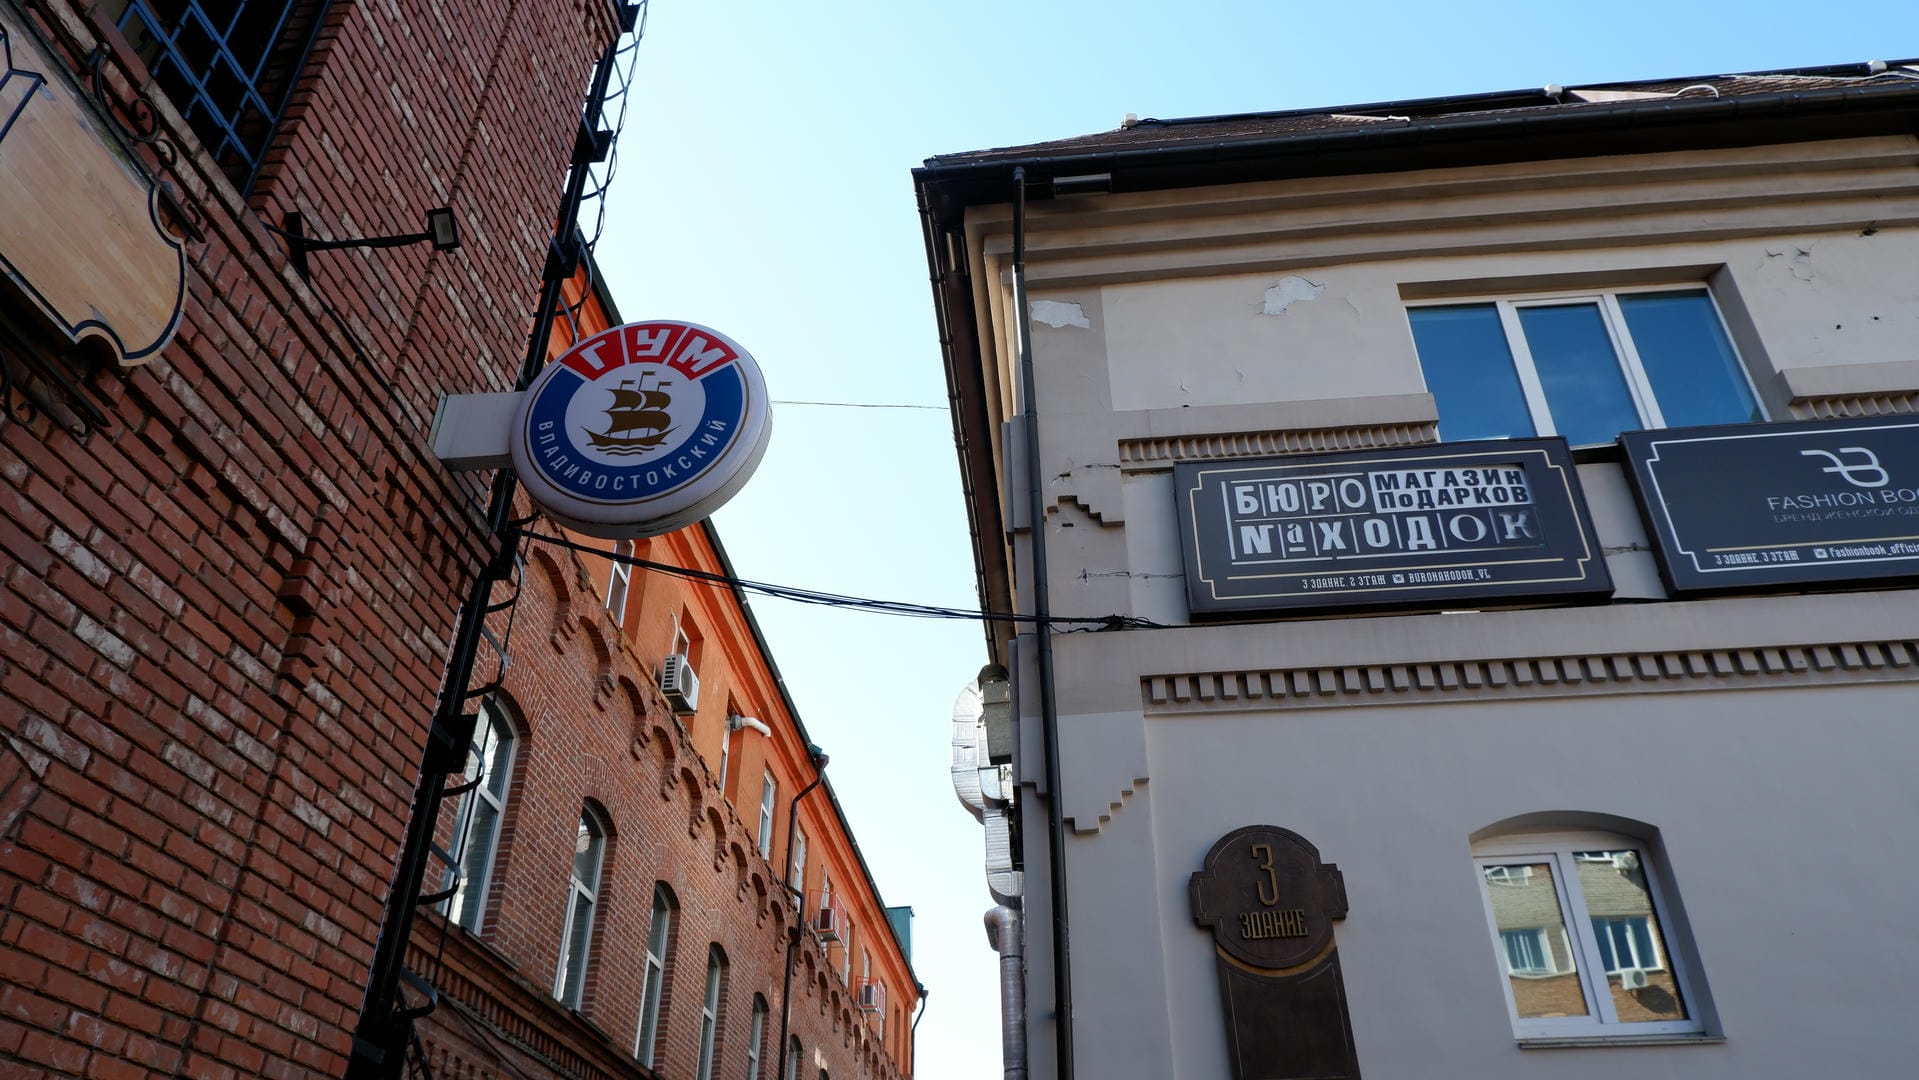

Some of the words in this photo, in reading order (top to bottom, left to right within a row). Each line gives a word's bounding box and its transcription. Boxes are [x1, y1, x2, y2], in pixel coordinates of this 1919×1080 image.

[579, 328, 727, 373] ГУМ
[538, 419, 728, 491] ВЛАДИВОСТОКСКИЙ
[1374, 469, 1523, 491] МАГАЗИН
[1234, 478, 1367, 514] БЮРО
[1767, 491, 1875, 510] FASHION
[1880, 488, 1919, 504] BO
[1715, 554, 1723, 565] 3
[1763, 552, 1770, 563] 3
[1771, 550, 1800, 561] ЭТАЖ
[1302, 579, 1308, 590] 3
[1350, 576, 1356, 587] 2
[1358, 574, 1386, 586] ЭТАЖ
[1251, 843, 1280, 906] 3
[1239, 909, 1309, 939] ЗДАНИЕ
